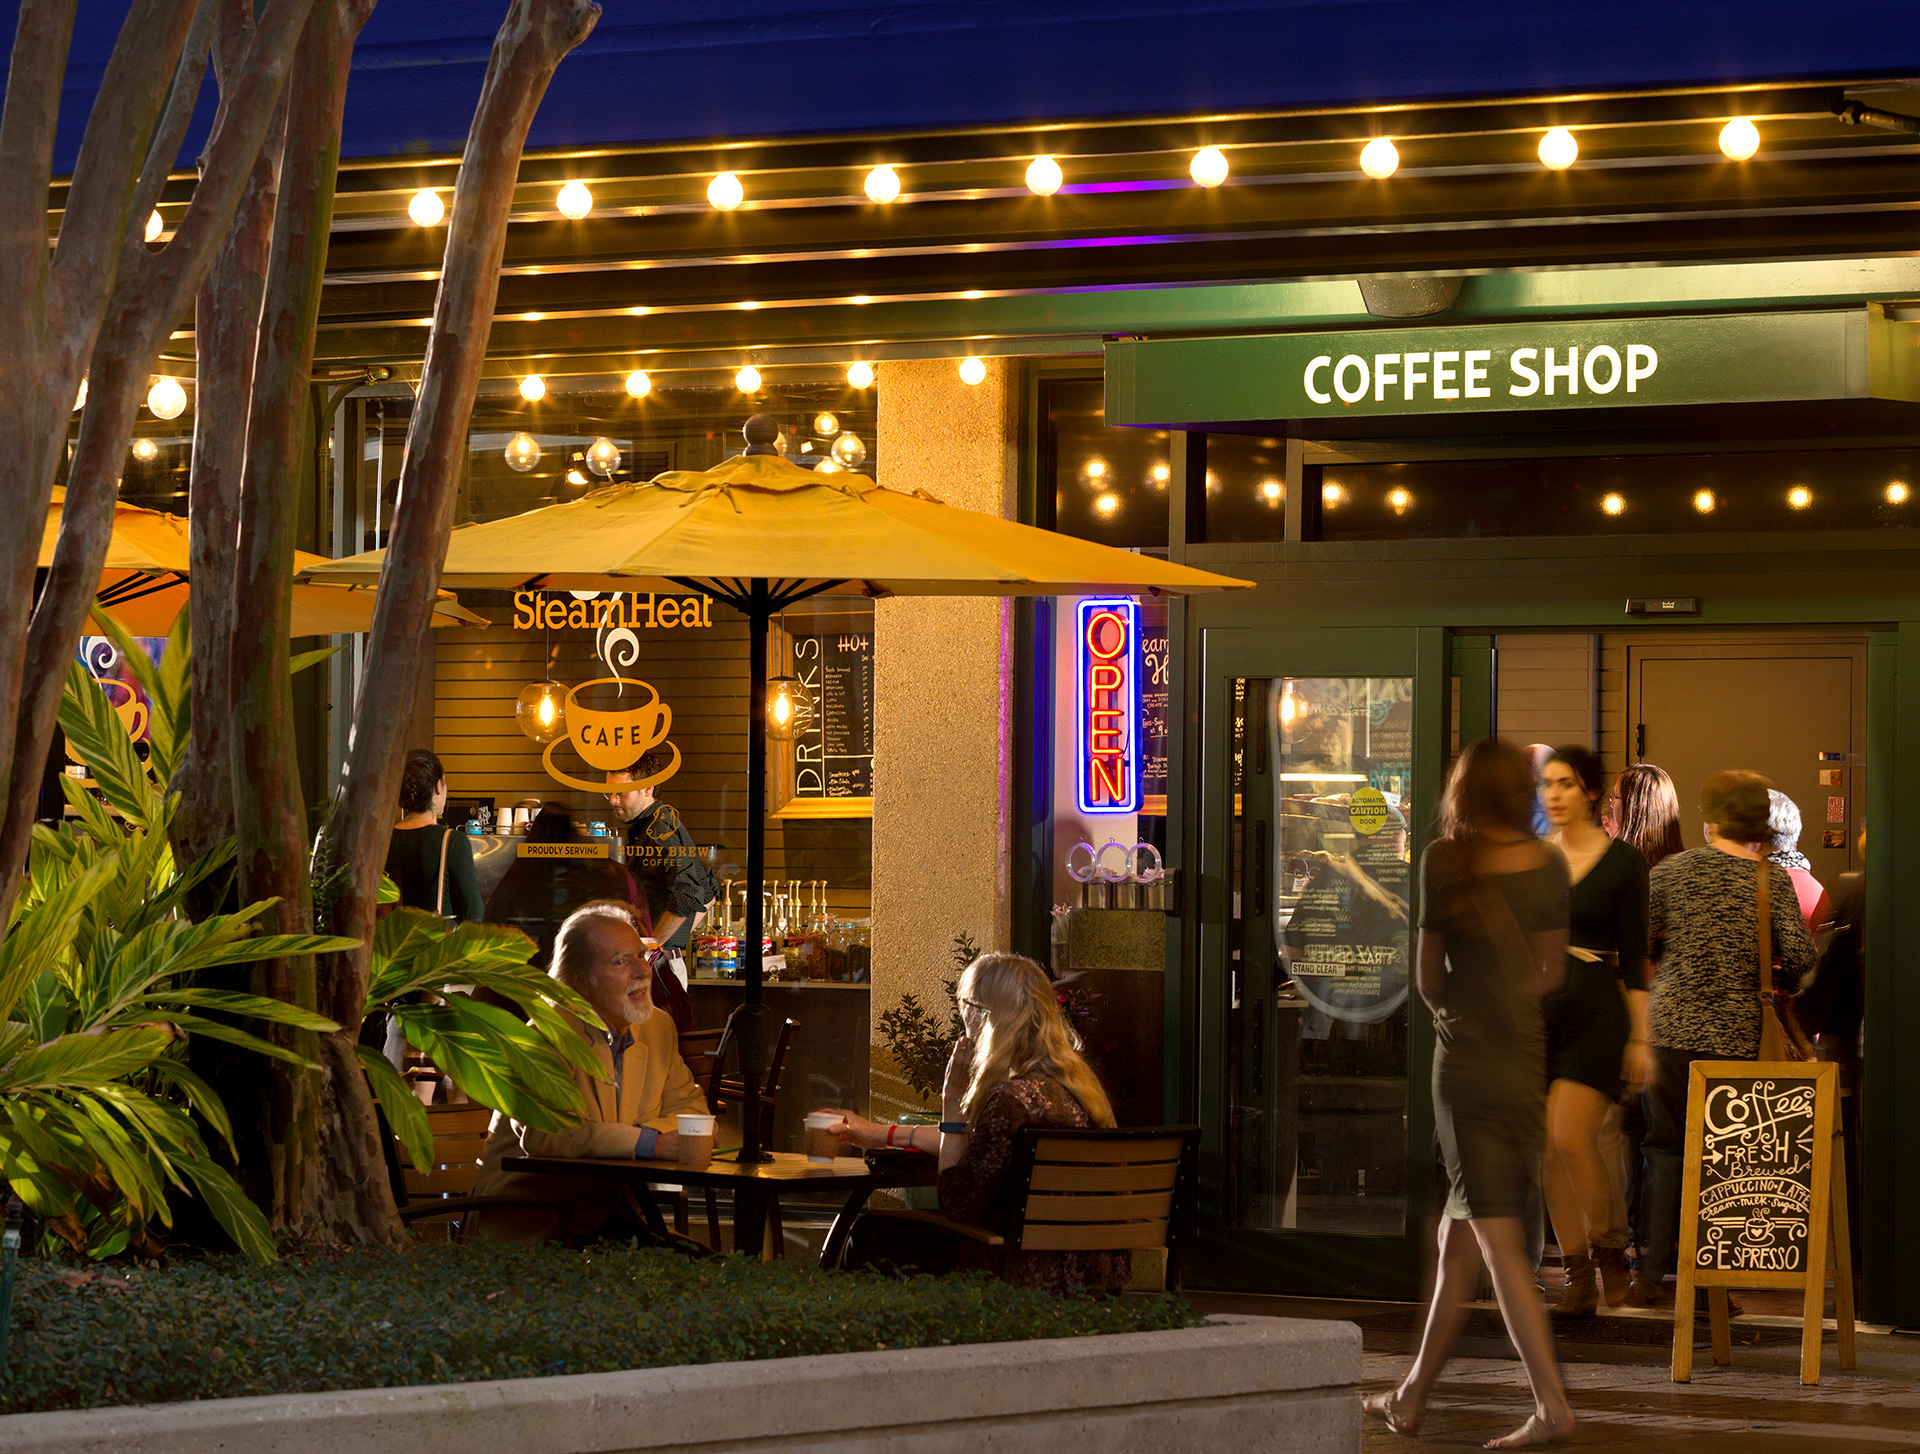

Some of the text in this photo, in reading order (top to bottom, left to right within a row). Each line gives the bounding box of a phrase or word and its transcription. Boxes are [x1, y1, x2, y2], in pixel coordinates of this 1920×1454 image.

[1303, 344, 1659, 405] COFFEE SHOP
[1086, 611, 1126, 802] OPEN
[580, 724, 642, 747] CAFE
[1350, 806, 1386, 815] CAUTION
[527, 845, 598, 855] PROUDLY SERVING
[617, 845, 709, 857] BUDDY BREW
[642, 858, 682, 867] COFFEE
[1292, 963, 1338, 974] STAND CLEAR
[1704, 1080, 1816, 1147] Coffee
[1724, 1131, 1790, 1166] FRESH
[1729, 1155, 1803, 1179] Brewed
[1770, 1197, 1803, 1215] sugar
[1717, 1240, 1800, 1270] ESPRESSO
